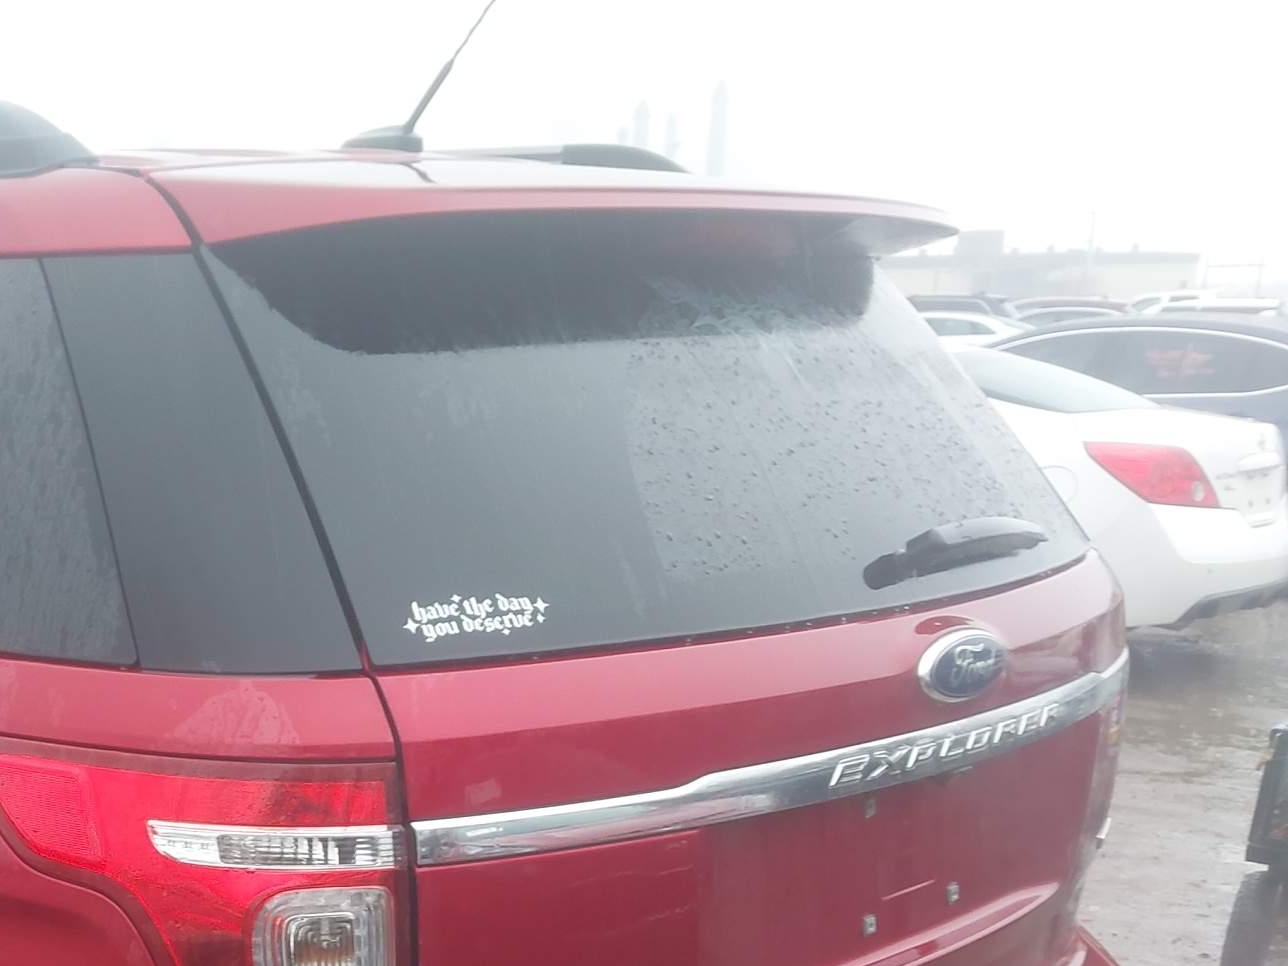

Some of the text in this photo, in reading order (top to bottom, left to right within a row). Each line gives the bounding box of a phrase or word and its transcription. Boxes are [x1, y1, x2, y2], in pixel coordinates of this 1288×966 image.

[410, 593, 534, 624] have the day
[420, 611, 535, 643] you deserve
[828, 703, 1061, 788] EXPLORER
